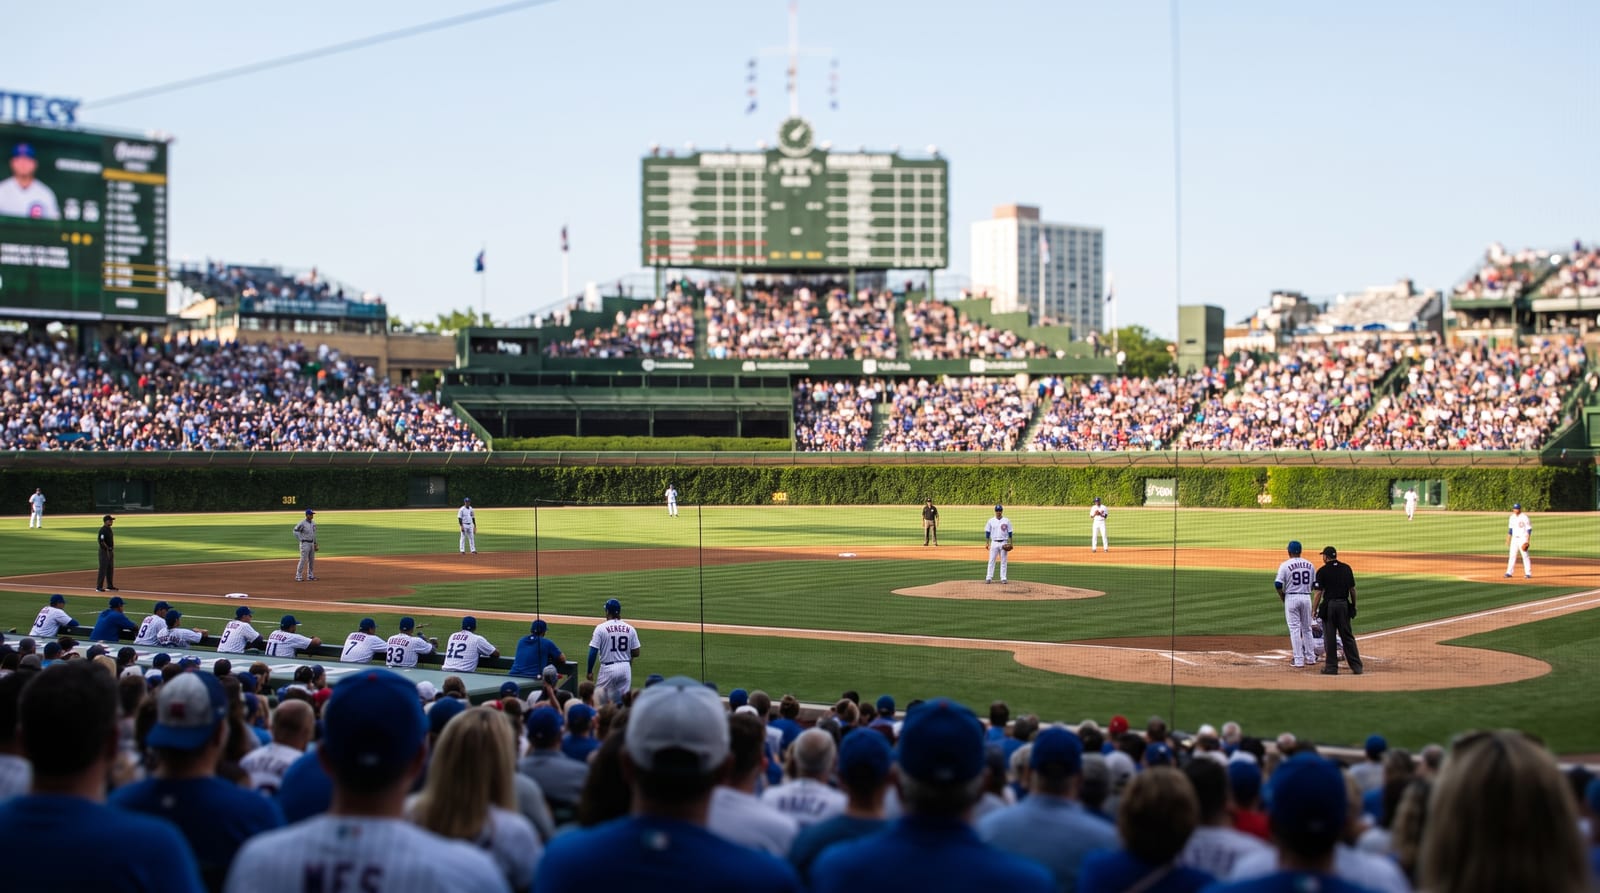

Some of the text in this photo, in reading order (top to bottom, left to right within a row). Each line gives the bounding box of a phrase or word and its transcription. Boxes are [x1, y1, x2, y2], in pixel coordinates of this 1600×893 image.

[1292, 571, 1310, 585] 98
[345, 641, 358, 655] 7
[446, 642, 467, 660] 12
[610, 635, 629, 652] 18
[386, 646, 405, 663] 33
